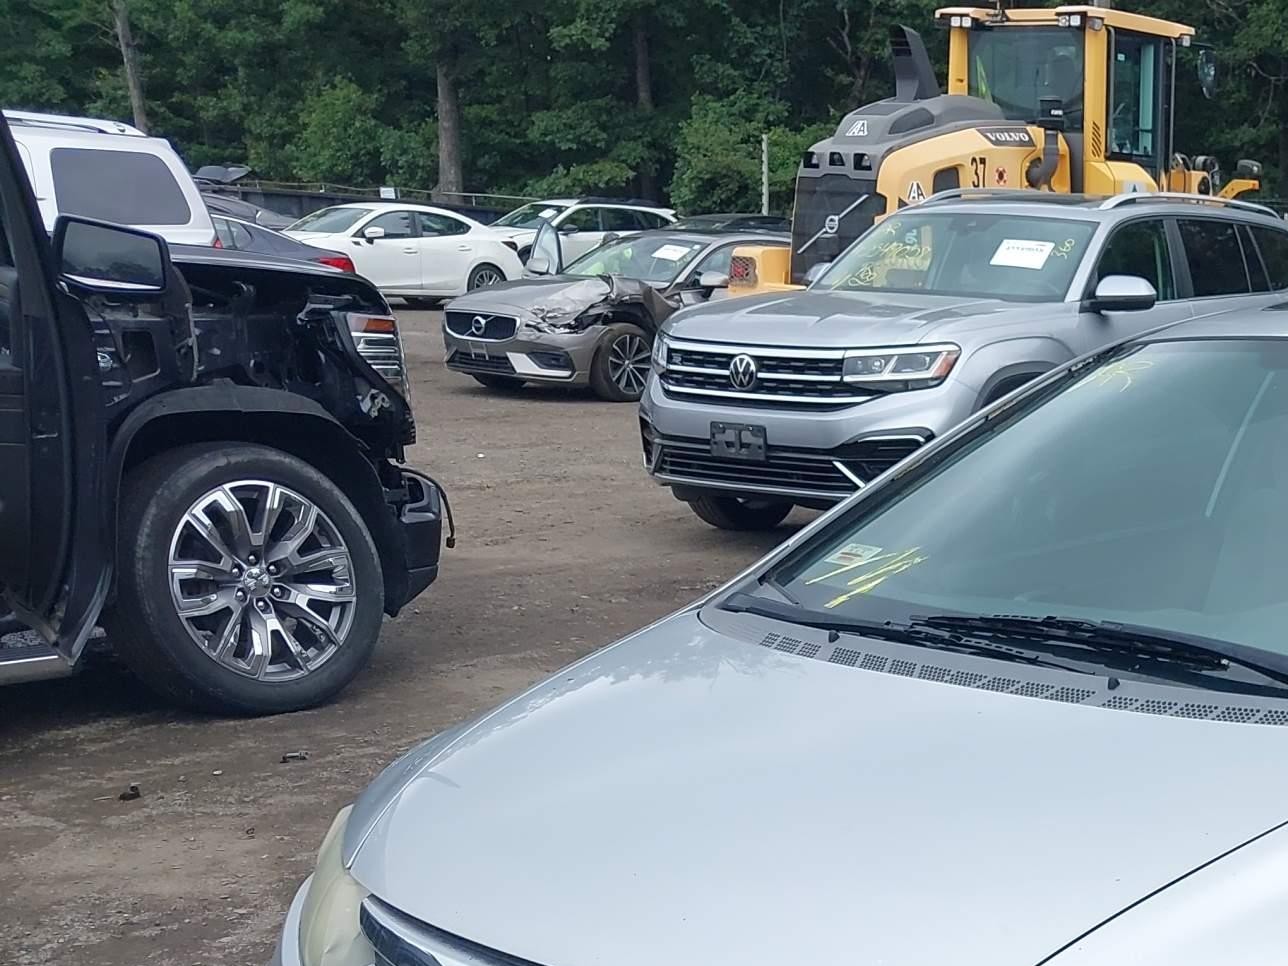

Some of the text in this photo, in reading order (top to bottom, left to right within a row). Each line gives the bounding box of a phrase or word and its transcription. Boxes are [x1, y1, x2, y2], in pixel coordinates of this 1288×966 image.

[985, 131, 1030, 142] VOLVO
[970, 157, 987, 188] 37
[1051, 238, 1075, 260] 360
